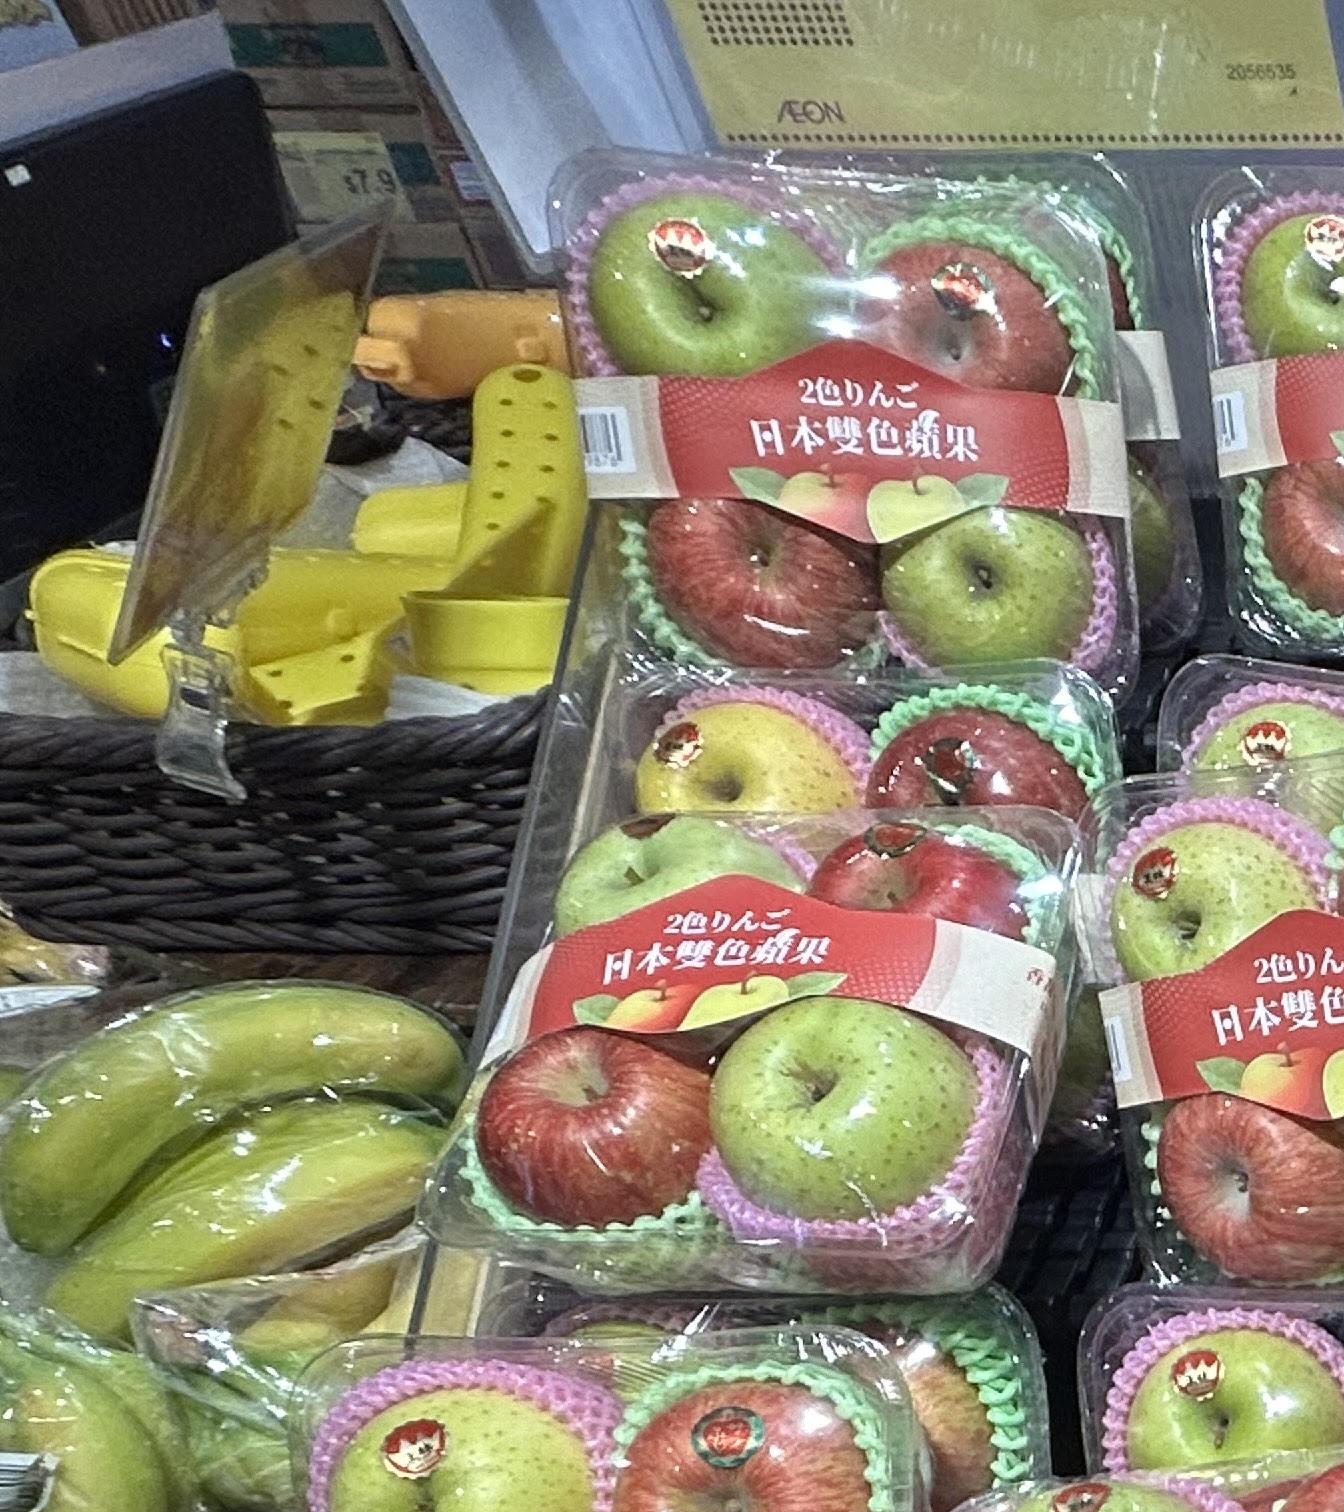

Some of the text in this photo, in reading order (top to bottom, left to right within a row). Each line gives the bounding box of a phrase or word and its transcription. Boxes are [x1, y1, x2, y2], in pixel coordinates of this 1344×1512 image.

[799, 376, 919, 410] 2色りんご
[751, 409, 980, 463] 日本雙色蘋果
[664, 910, 791, 935] 2色りんご
[603, 928, 831, 985] 日本雙色蘋果
